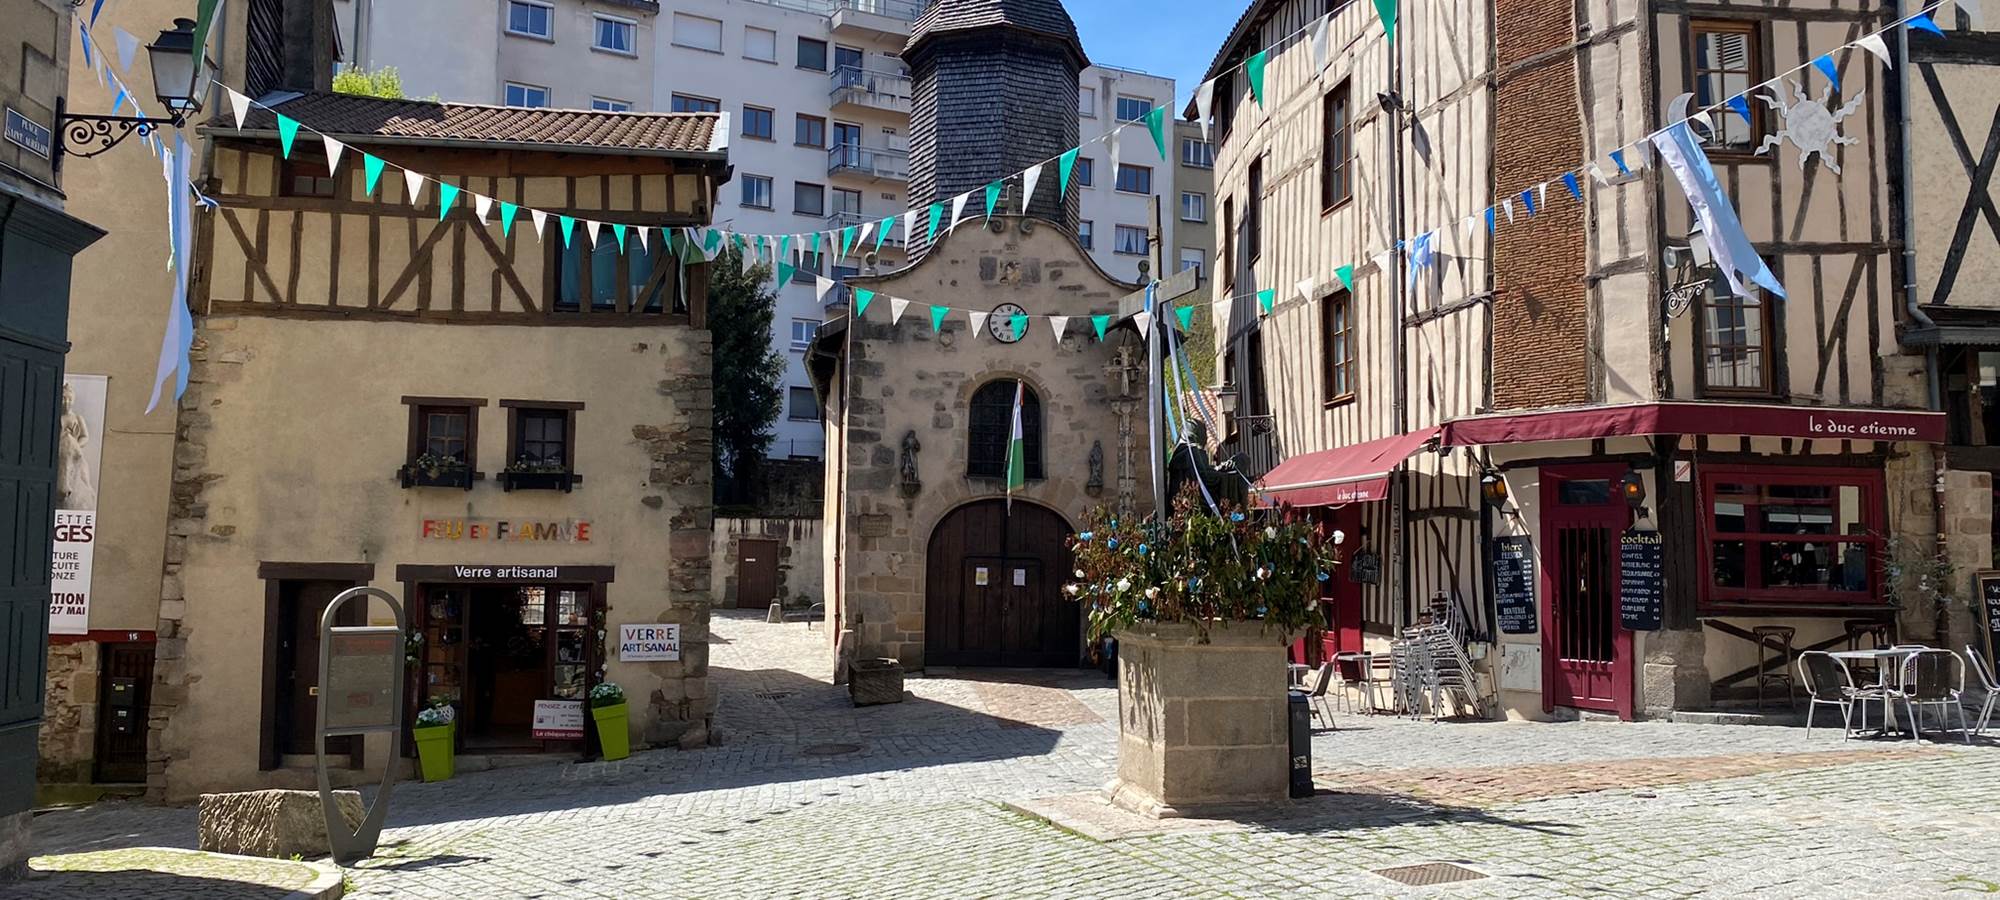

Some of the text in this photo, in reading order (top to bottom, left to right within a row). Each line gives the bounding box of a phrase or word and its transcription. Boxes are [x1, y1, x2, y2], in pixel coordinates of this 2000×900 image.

[7, 127, 23, 142] SAINT
[21, 118, 39, 137] PLACE
[1809, 415, 1917, 436] le duc etienne
[54, 524, 93, 543] GES
[422, 520, 464, 540] FEU
[497, 521, 591, 543] FLAMME
[1620, 532, 1663, 545] cocktail
[455, 566, 558, 578] Verre artisanal
[50, 605, 86, 616] 27 MAI
[128, 632, 139, 641] 15
[625, 627, 675, 641] VERRE
[621, 642, 679, 652] ARTISANAL
